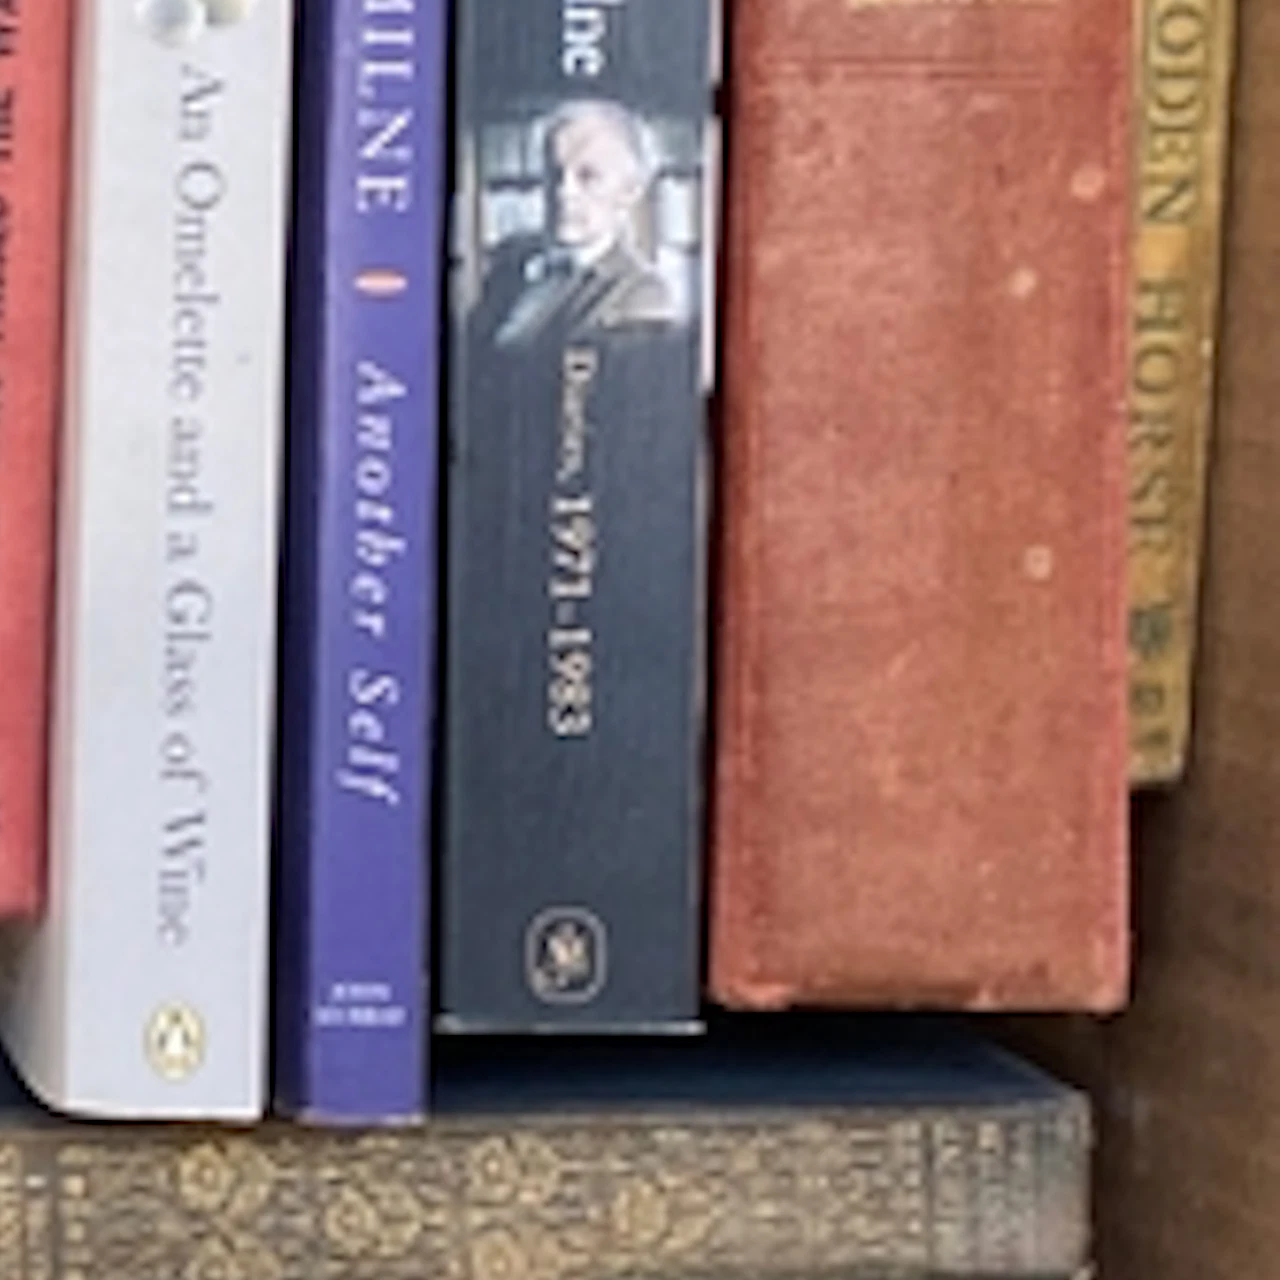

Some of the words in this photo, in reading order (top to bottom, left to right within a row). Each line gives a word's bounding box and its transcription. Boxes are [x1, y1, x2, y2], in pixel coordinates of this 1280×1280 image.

[176, 62, 227, 144] An
[168, 159, 228, 402] Omelette
[164, 414, 216, 516] and
[1128, 272, 1192, 562] HORSE
[164, 530, 197, 564] a
[346, 358, 409, 639] Another
[161, 578, 215, 719] Glass
[546, 492, 594, 738] 1971-1983
[156, 730, 209, 790] of
[334, 666, 402, 807] Self
[154, 807, 208, 952] Wine
